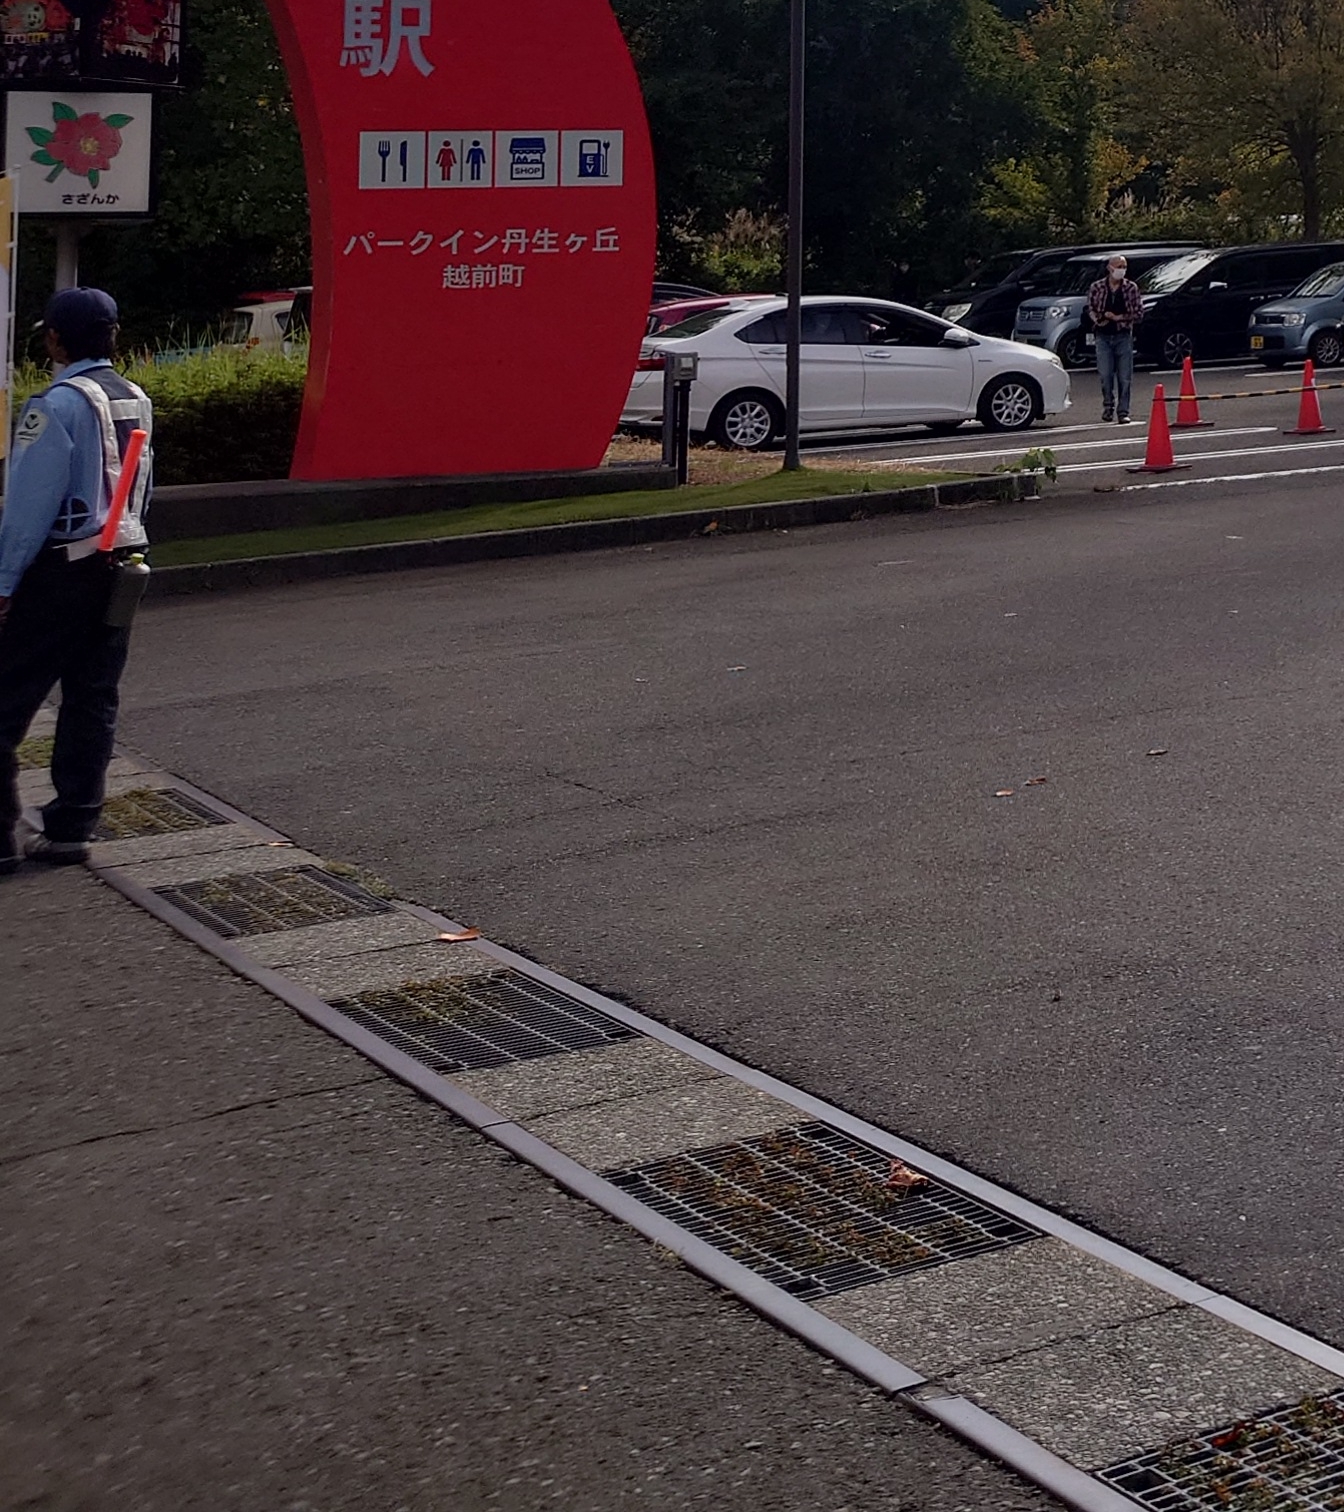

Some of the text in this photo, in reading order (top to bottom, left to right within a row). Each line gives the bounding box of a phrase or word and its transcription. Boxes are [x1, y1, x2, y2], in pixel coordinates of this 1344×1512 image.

[514, 167, 540, 175] SHOP
[586, 155, 594, 173] EV
[61, 193, 120, 205] さざんか
[343, 227, 620, 255] パークイン丹生ヶ丘
[442, 264, 525, 289] 越前町
